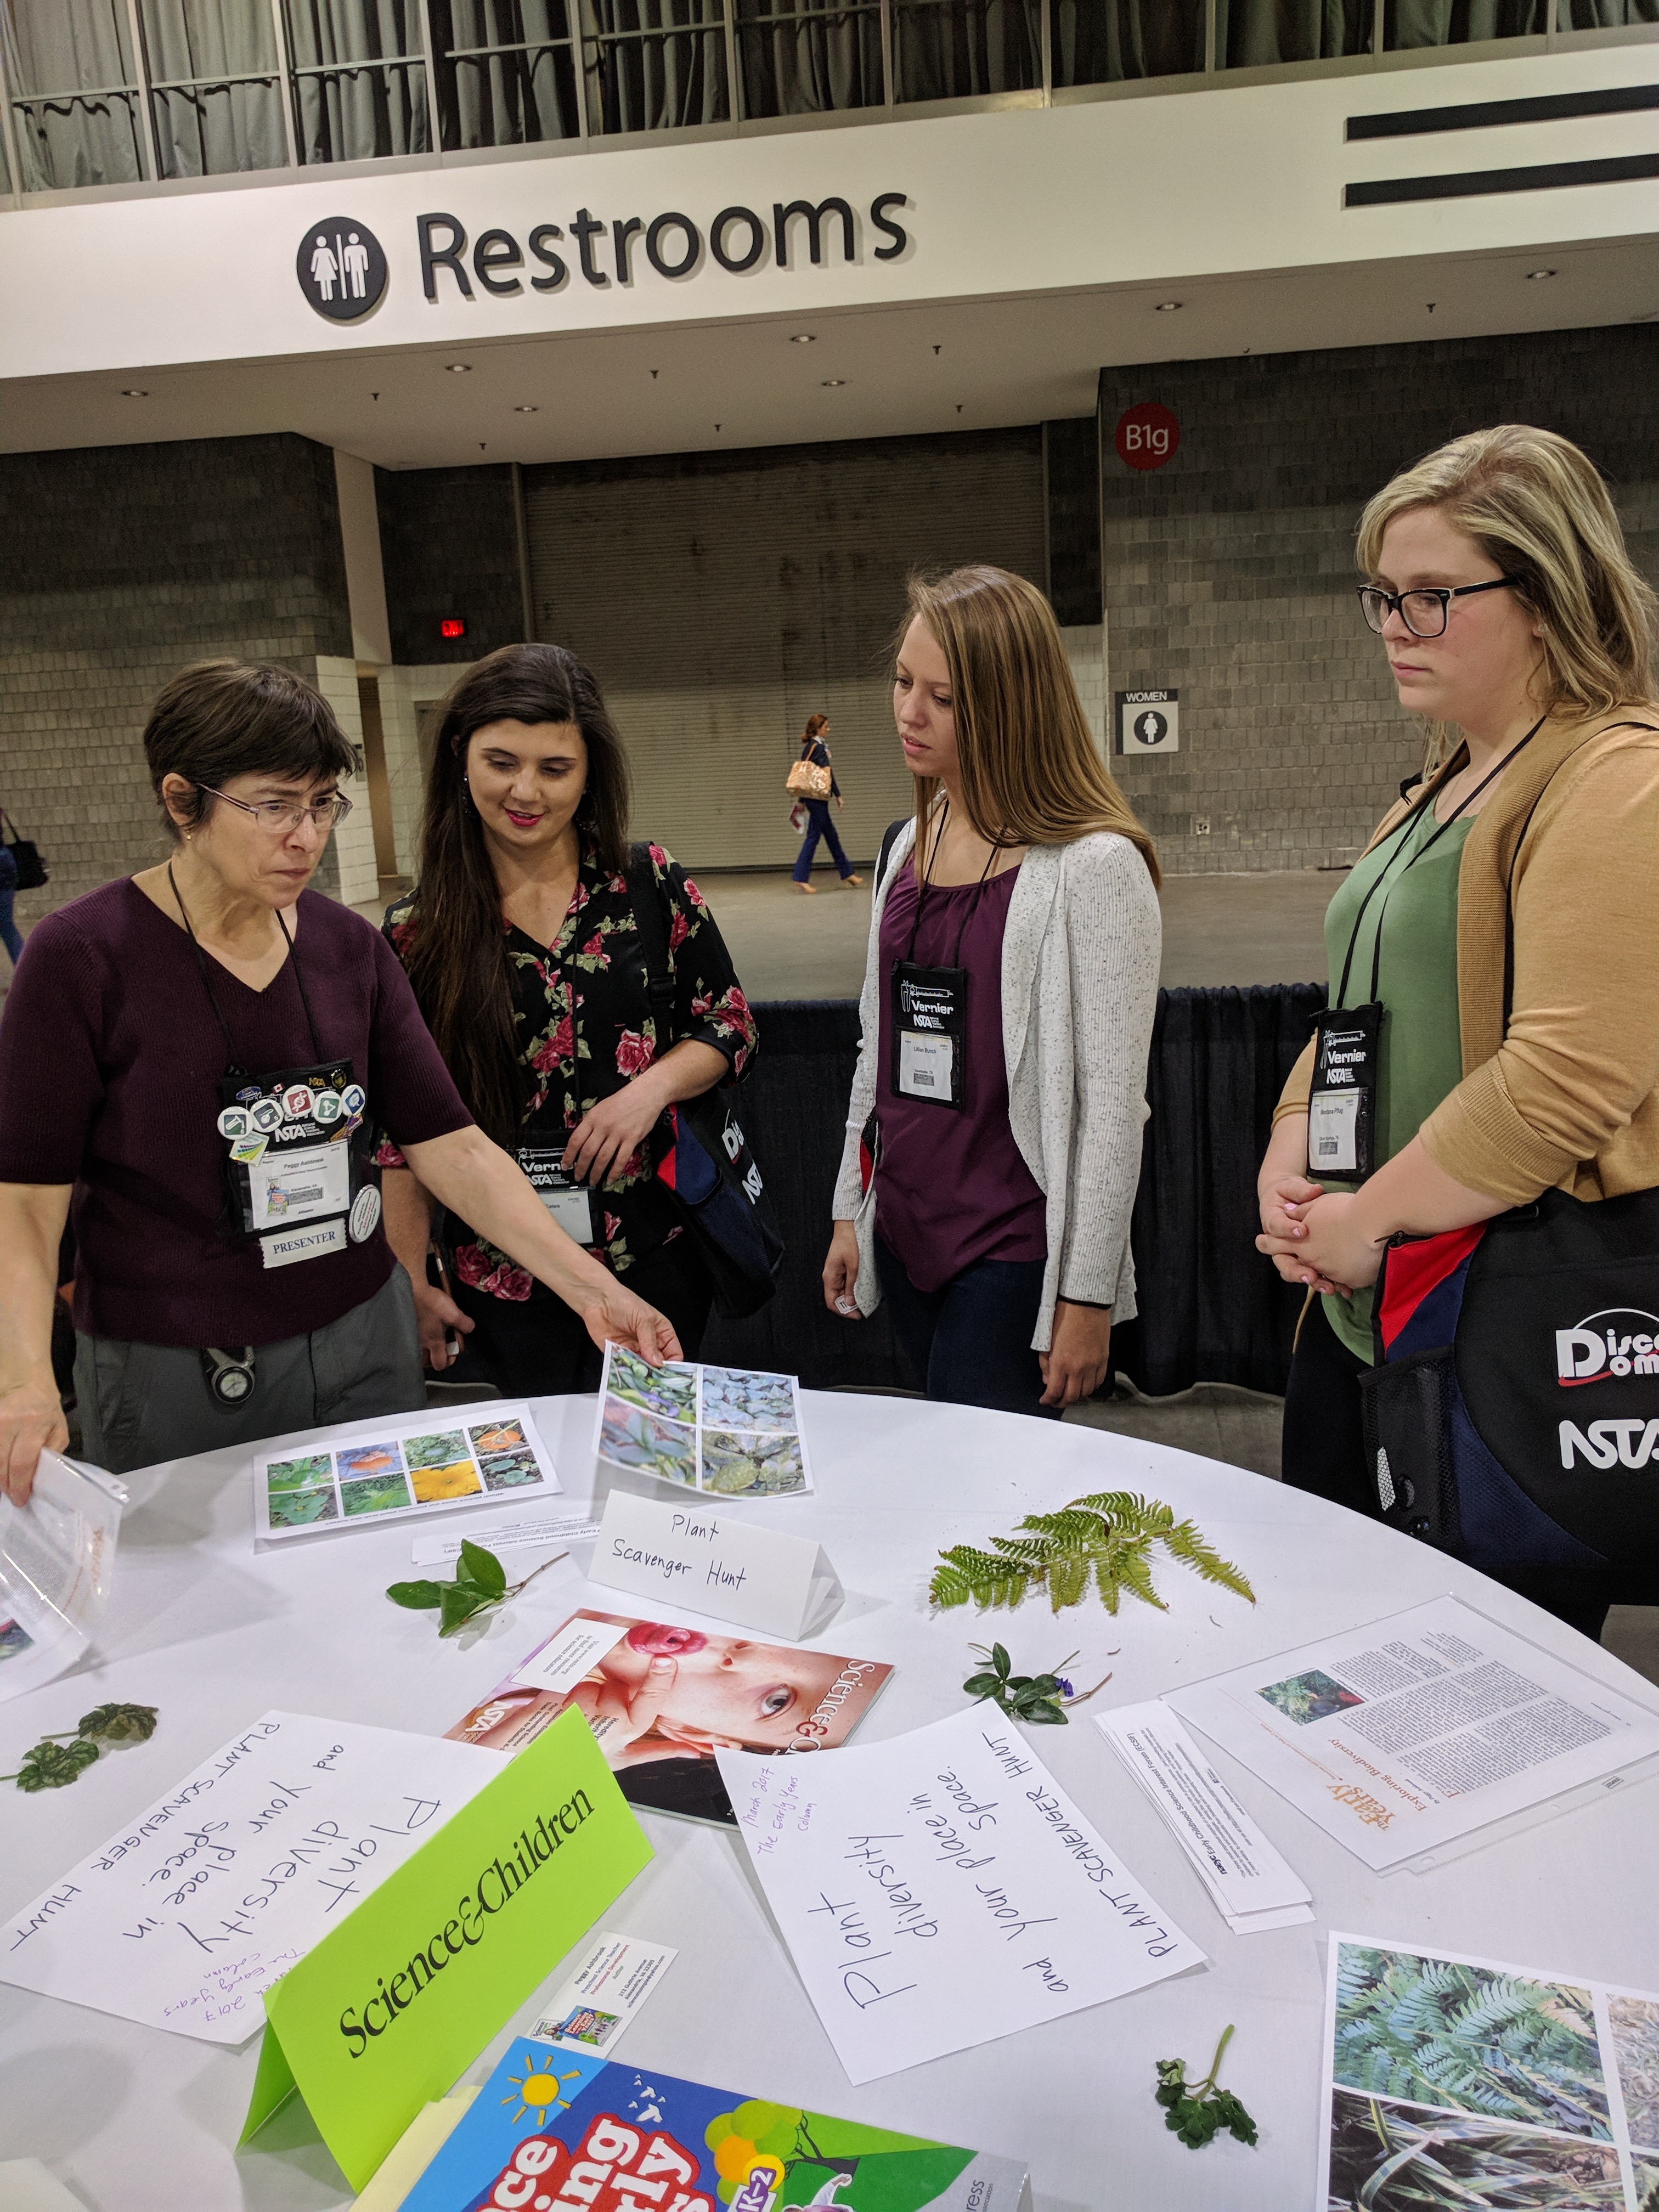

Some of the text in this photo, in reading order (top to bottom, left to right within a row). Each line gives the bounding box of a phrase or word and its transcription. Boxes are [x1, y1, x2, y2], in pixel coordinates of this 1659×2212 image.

[416, 192, 909, 299] Restrooms
[1126, 424, 1169, 455] B1g
[1125, 691, 1167, 702] WOMEN
[911, 999, 954, 1014] Vernier
[913, 1014, 933, 1029] NSTA
[1327, 1048, 1367, 1064] Vernier
[1327, 1068, 1345, 1084] NSTA
[274, 1124, 307, 1143] NSTA
[273, 1231, 336, 1255] PRESENTER
[671, 1514, 720, 1542] Plant
[612, 1538, 747, 1591] Scavenger Hunt
[465, 1700, 514, 1732] NSTA
[591, 1716, 611, 1734] Inherit
[313, 1745, 345, 1771] and
[1328, 1739, 1381, 1776] Biodiversity
[740, 1767, 775, 1828] March 2017
[906, 1792, 933, 1816] in
[1127, 1733, 1228, 1875] naeyc Early Childhood Science Interest Forum (ECSIF)
[1326, 1784, 1383, 1826] Early
[1351, 1786, 1396, 1825] Years
[1381, 1774, 1427, 1812] Exploring
[757, 1776, 799, 1854] The Early Years
[1373, 1816, 1390, 1831] The
[9, 1722, 280, 1951] PLANT SCAVENGER HUNT
[317, 1795, 442, 1913] Plant
[924, 1818, 997, 1871] place
[981, 1731, 1180, 1960] PLANT SCAVENGER HUNT
[162, 1844, 236, 1905] place
[177, 1820, 349, 1954] diversity
[843, 1834, 939, 1940] diversity
[122, 1920, 166, 1939] in
[340, 1788, 595, 2059] Science&Children
[574, 1946, 607, 1985] Peggy Ashbrook
[580, 1942, 622, 1994] Preschool Science Teacher
[807, 1891, 918, 2010] Plant
[219, 1966, 266, 1993] Early
[590, 1970, 611, 1995] Professional
[1023, 1957, 1070, 1994] and
[204, 1995, 246, 2022] 2017
[479, 2141, 557, 2212] ce
[534, 2118, 641, 2212] ing
[738, 2170, 773, 2212] K-2
[966, 2180, 985, 2212] ress
